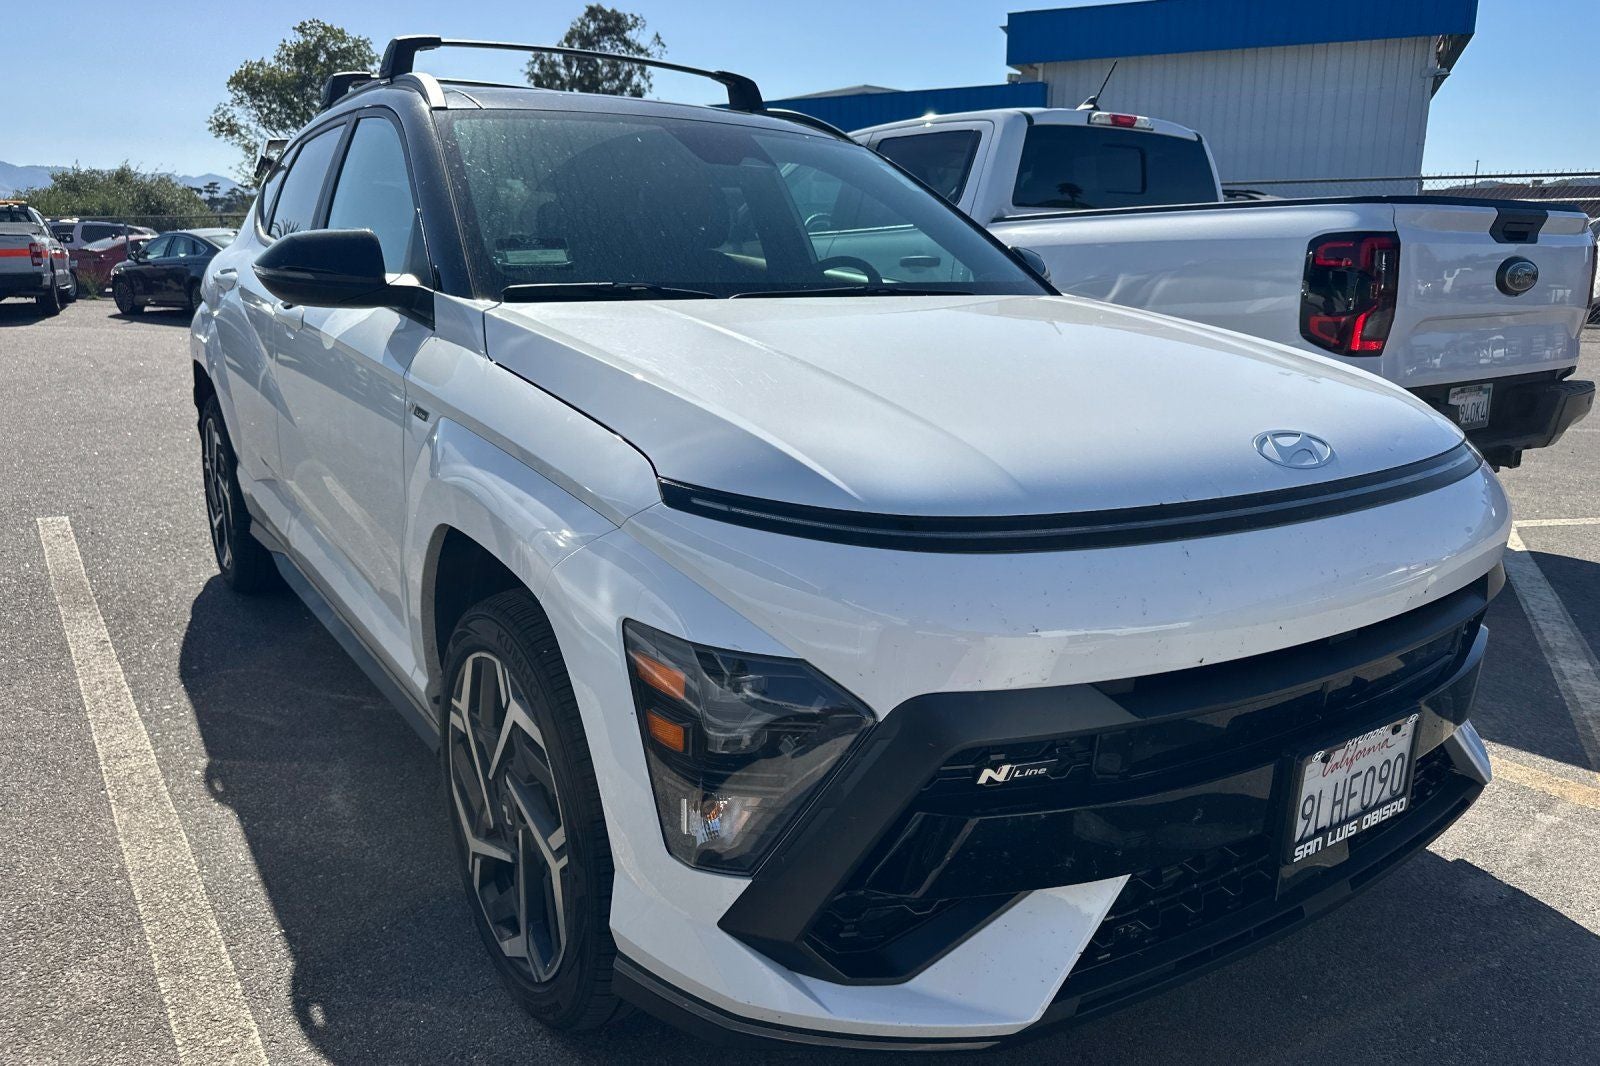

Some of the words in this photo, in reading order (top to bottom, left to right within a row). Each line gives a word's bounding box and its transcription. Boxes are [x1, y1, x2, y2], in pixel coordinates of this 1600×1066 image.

[1322, 738, 1395, 777] California
[1344, 726, 1389, 749] HYUNDAI
[1299, 752, 1406, 841] 9LHF090
[1293, 836, 1323, 863] SAN
[1327, 819, 1358, 847] LUIS
[1361, 797, 1407, 830] OBISPO
